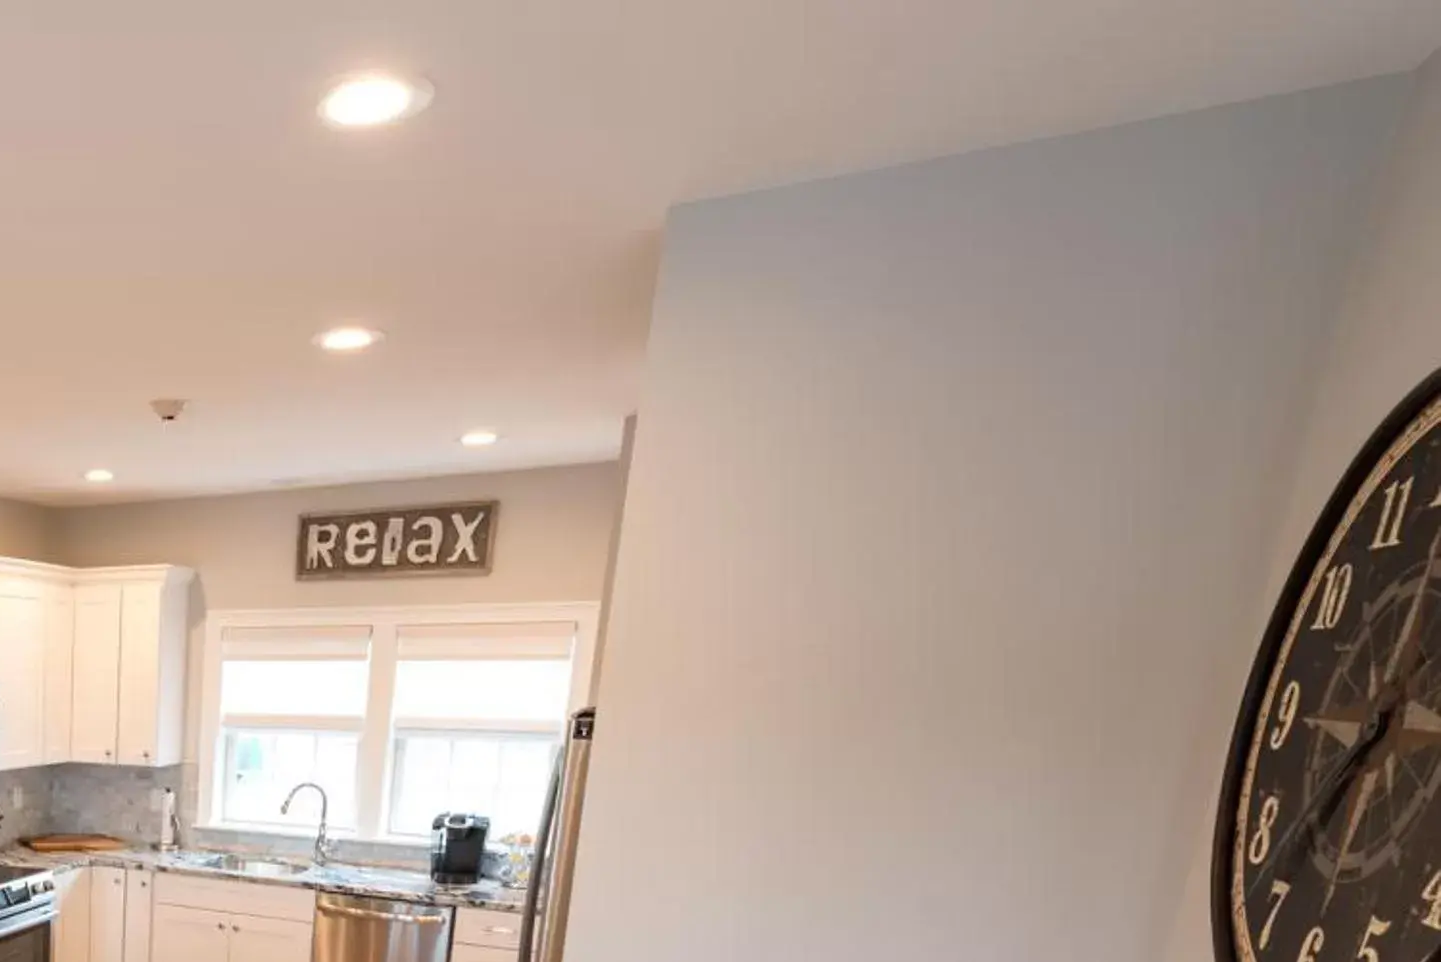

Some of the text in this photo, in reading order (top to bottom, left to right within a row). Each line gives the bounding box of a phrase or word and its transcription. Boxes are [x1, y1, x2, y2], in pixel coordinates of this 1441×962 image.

[1368, 476, 1415, 550] 11
[1310, 563, 1353, 630] 10
[1270, 680, 1301, 750] 9
[1249, 796, 1280, 865] 8
[1259, 879, 1292, 950] 7
